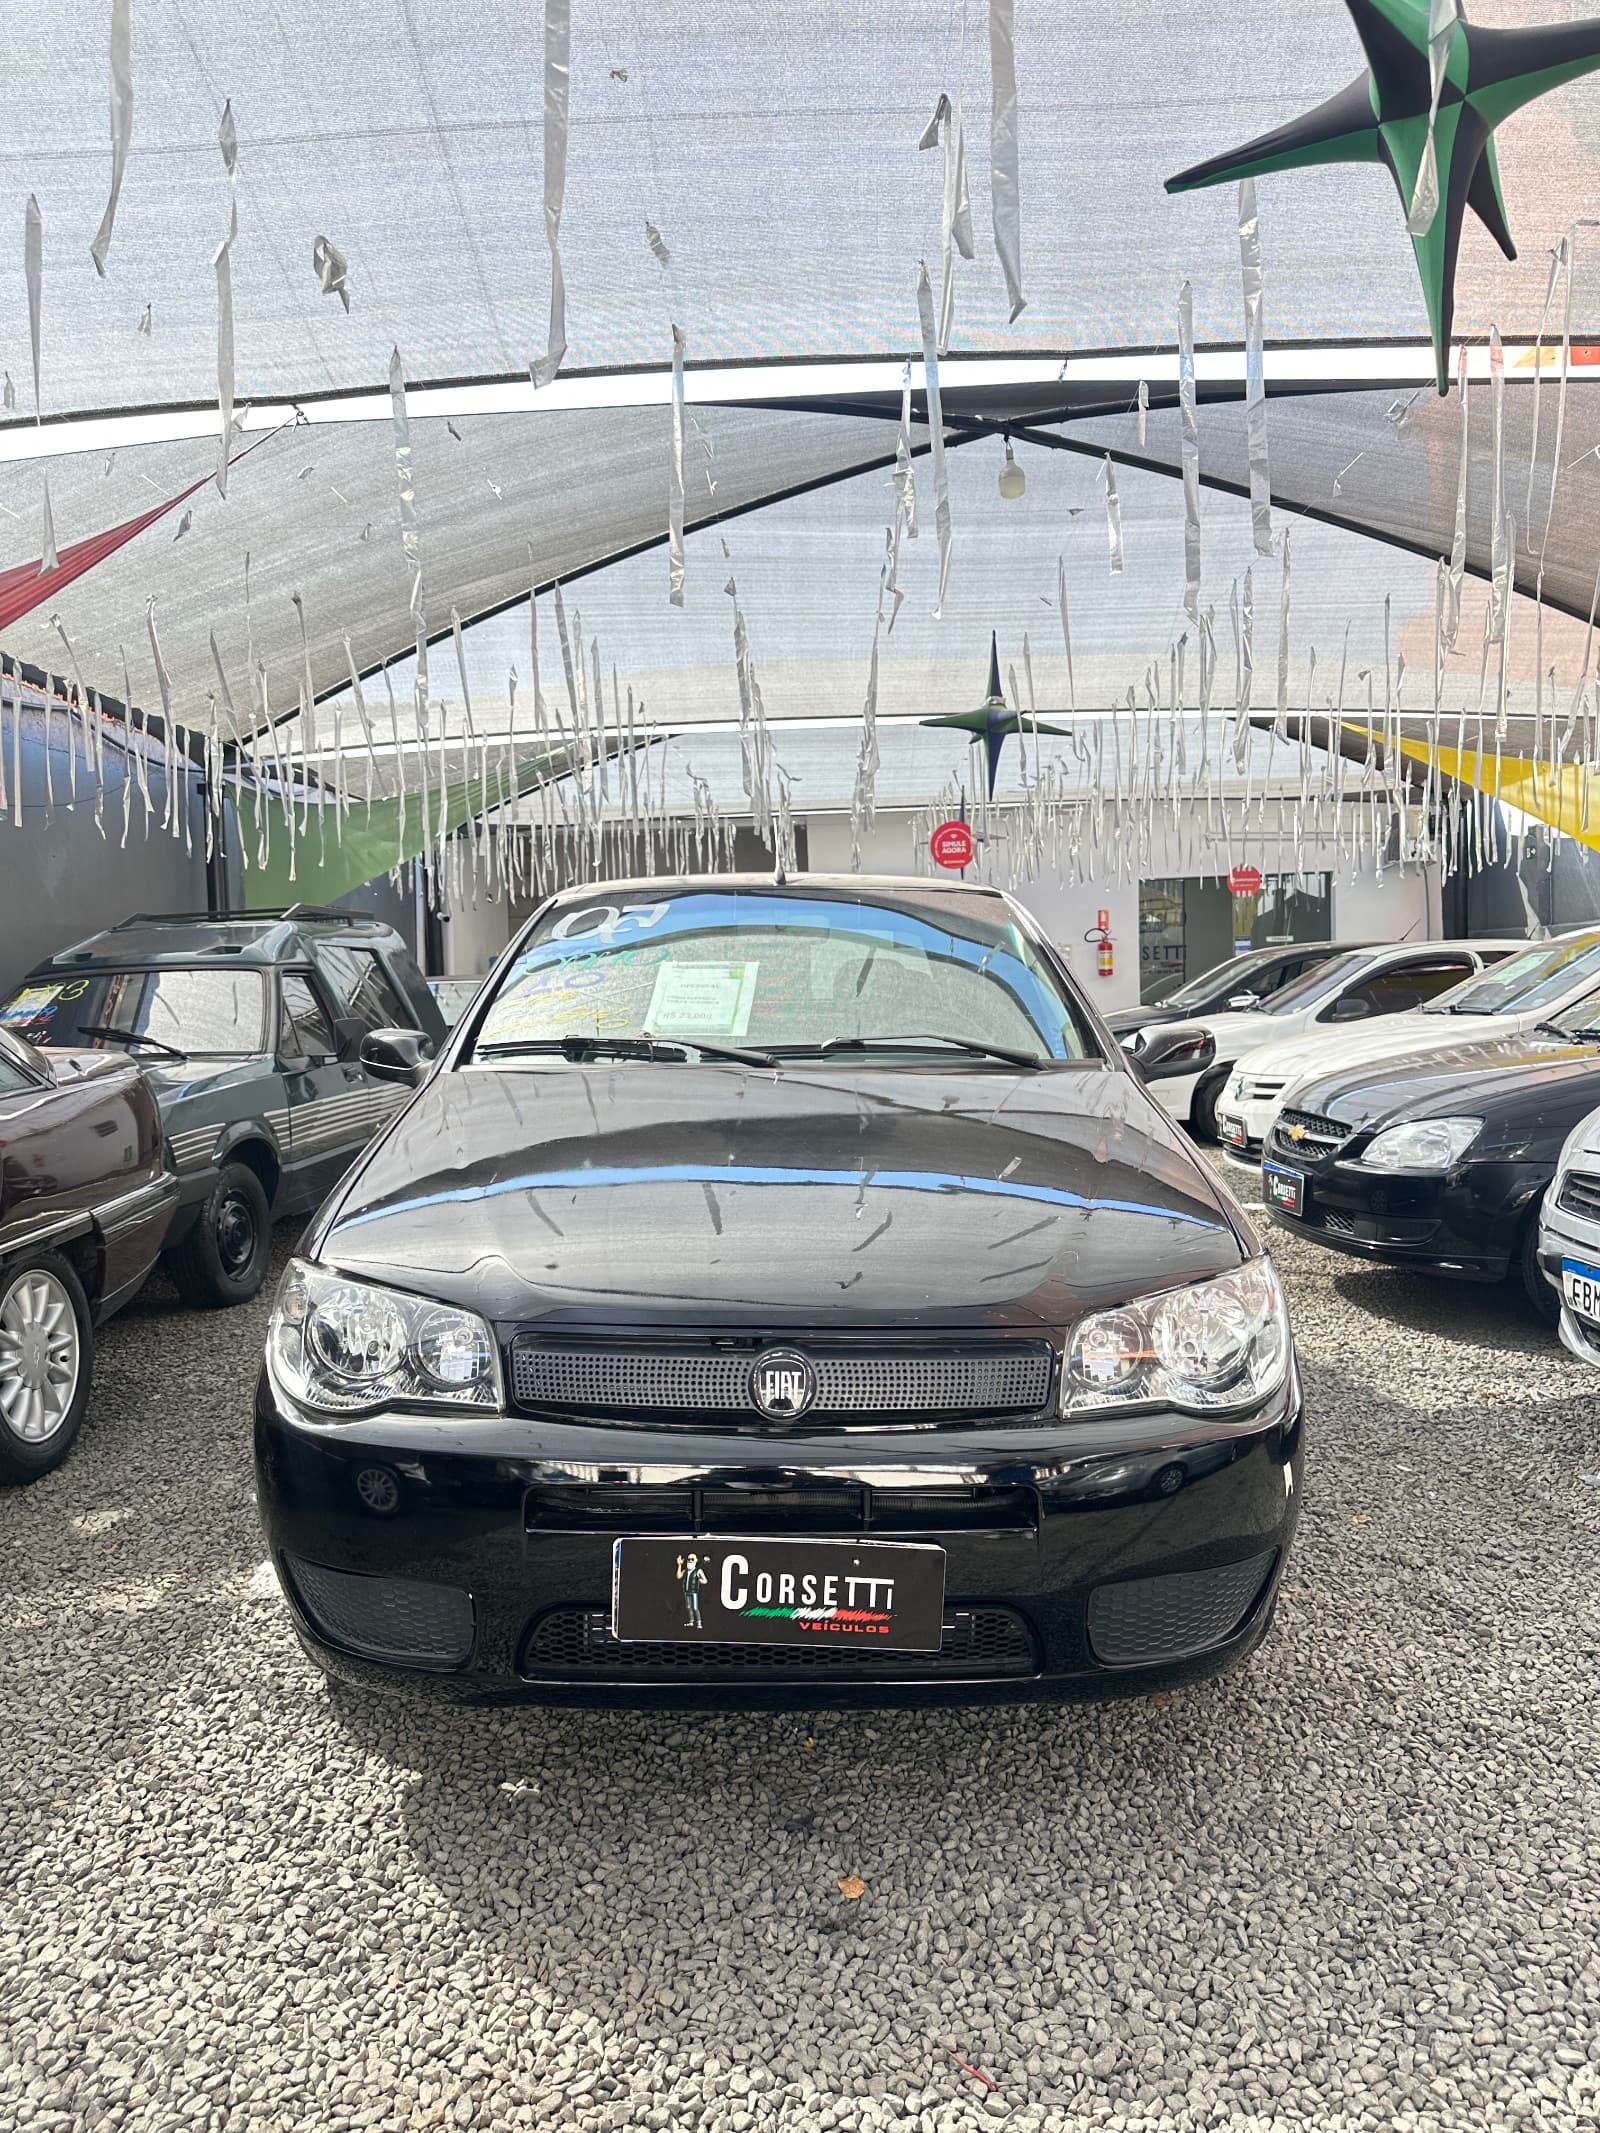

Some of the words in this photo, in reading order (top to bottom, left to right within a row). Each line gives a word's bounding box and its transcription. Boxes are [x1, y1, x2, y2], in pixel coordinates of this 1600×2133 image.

[942, 840, 967, 848] SIMULE
[765, 1370, 802, 1401] FIAT
[720, 1554, 895, 1610] CORSETTI
[800, 1619, 890, 1634] VEÍCULOS
